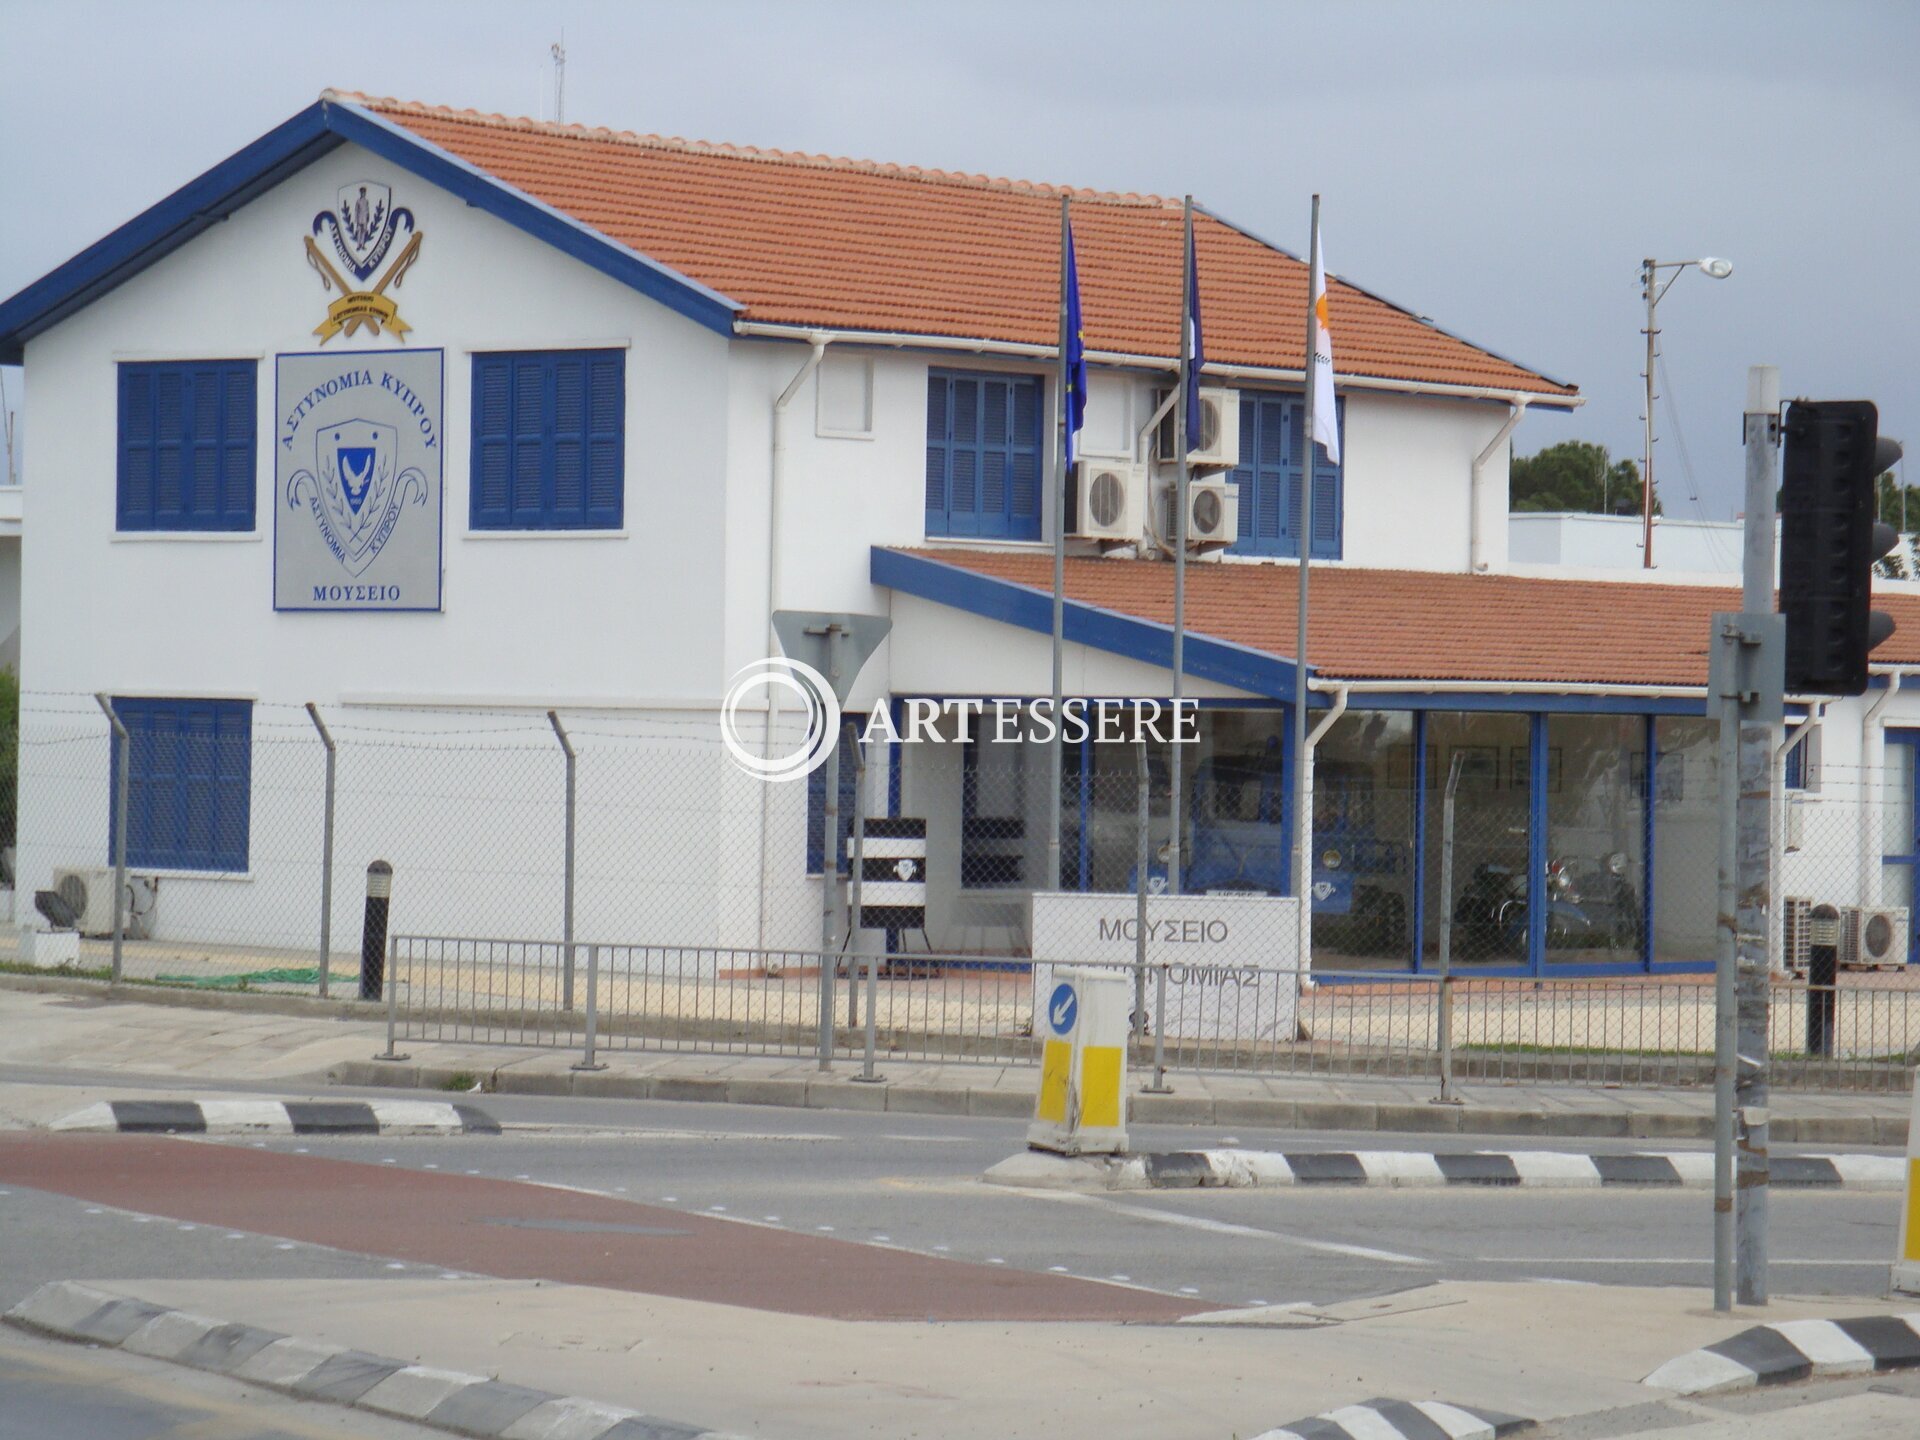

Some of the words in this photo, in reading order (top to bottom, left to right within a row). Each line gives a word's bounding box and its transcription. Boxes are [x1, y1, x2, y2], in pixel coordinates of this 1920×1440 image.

[282, 370, 373, 450] ΑΣΤΥΝΟΜΙΑ
[380, 372, 437, 450] ΚΥΠΡΟΥ
[309, 496, 346, 565] ΑΣΤΥΝΟΜΙΑ
[368, 502, 400, 555] ΚΥΠΡΟΥ
[313, 585, 400, 601] ΜΟΥΣΕΙΟ
[1099, 918, 1228, 943] ΜΟΥΣΕΙΟ
